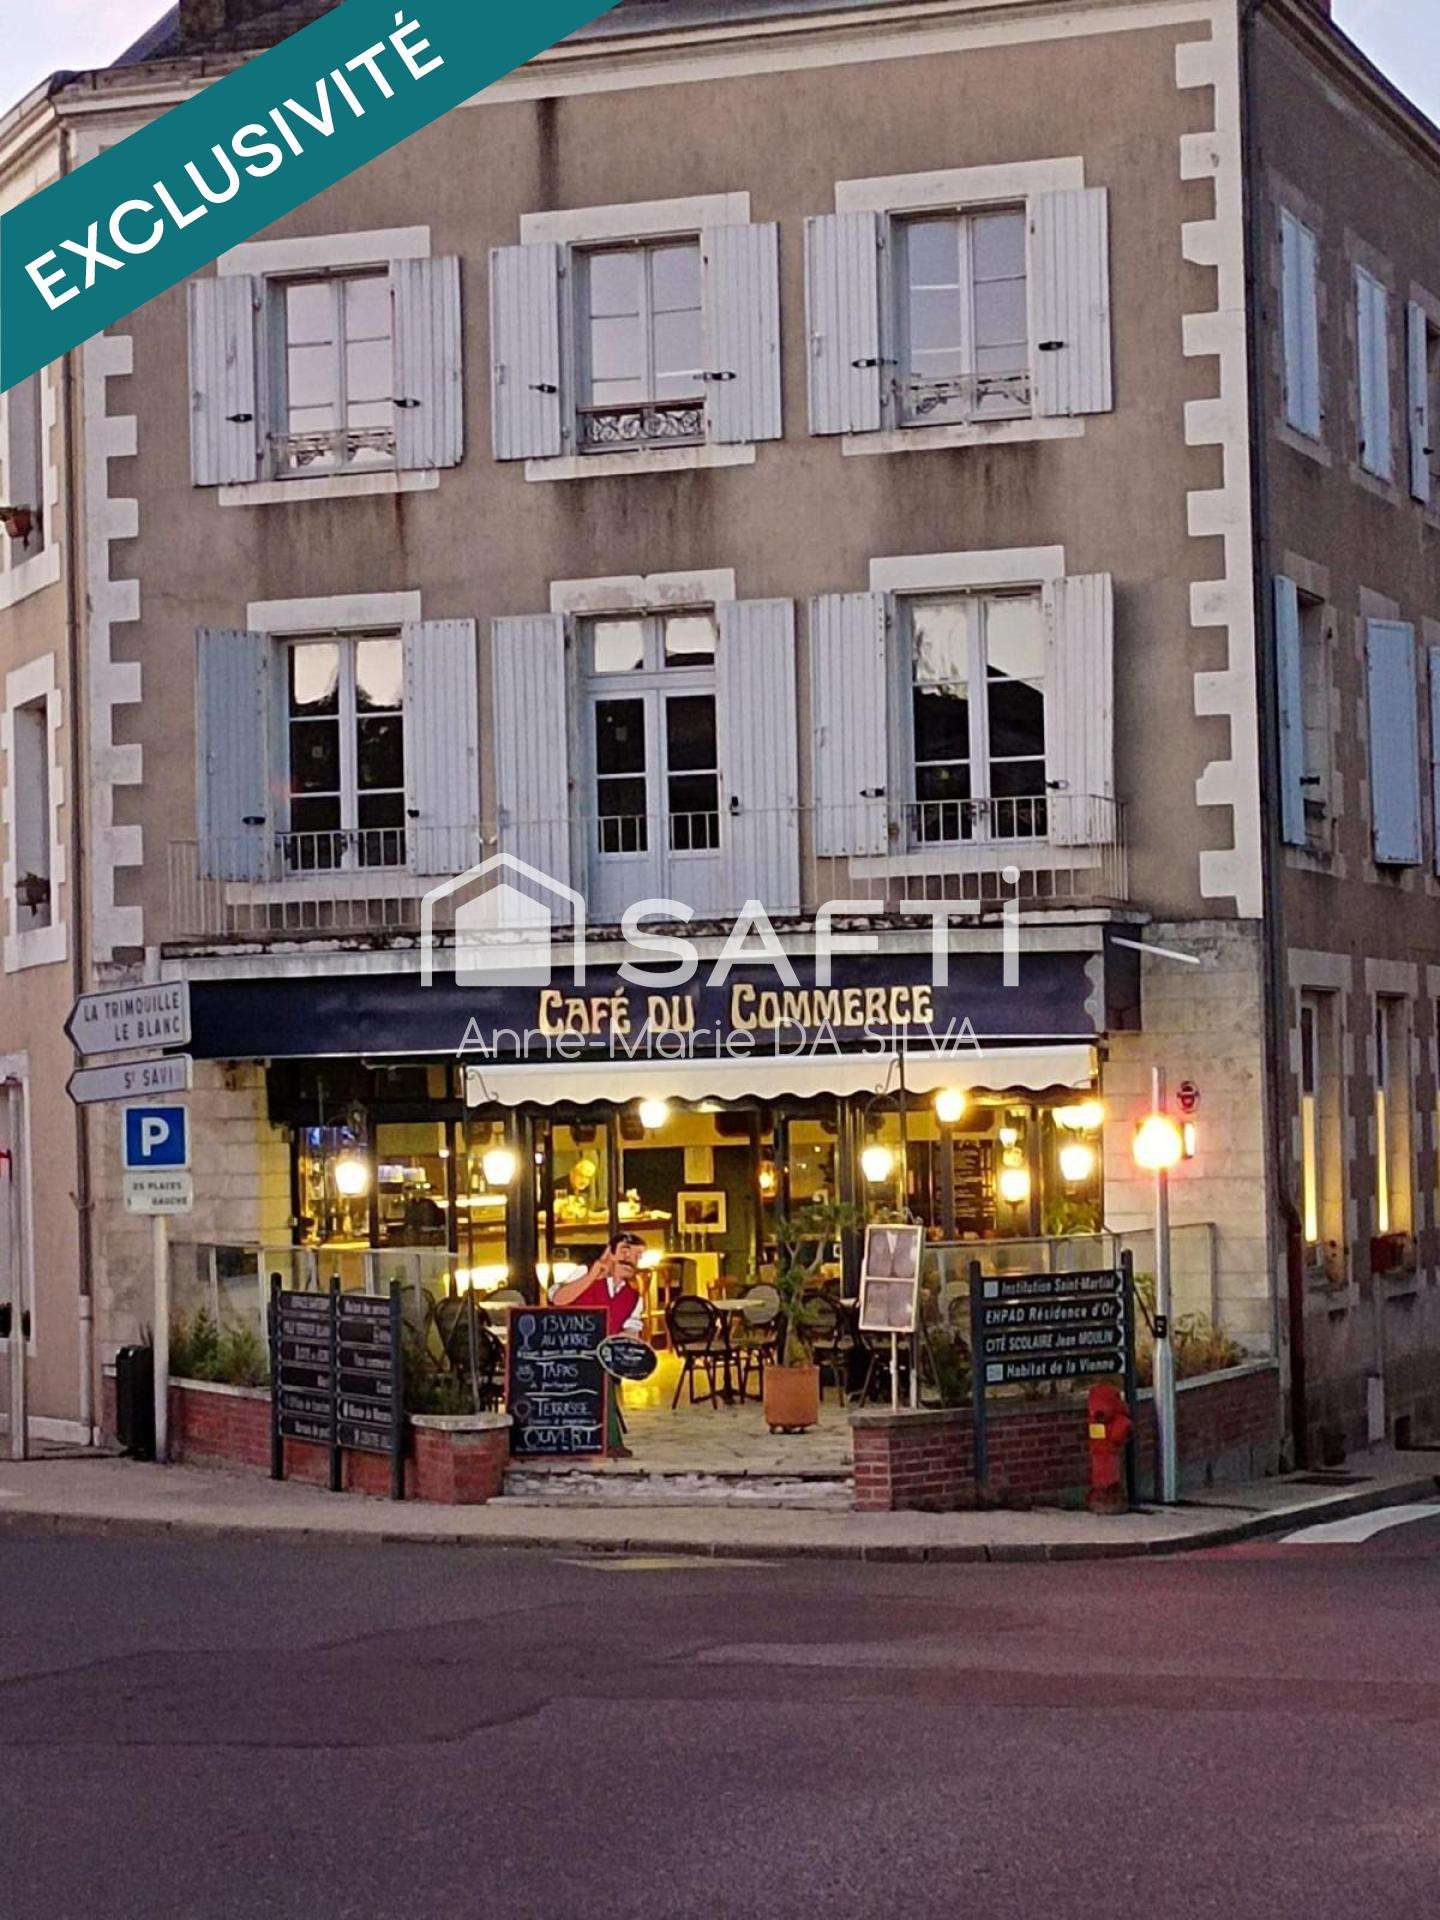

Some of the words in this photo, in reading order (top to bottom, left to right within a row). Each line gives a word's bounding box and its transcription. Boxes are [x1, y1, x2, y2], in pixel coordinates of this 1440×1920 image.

[84, 1005, 98, 1022] LA
[105, 992, 180, 1018] TRIMOUILLE
[115, 1023, 129, 1041] LE
[138, 1016, 180, 1038] BLANC
[141, 1118, 170, 1157] P
[1002, 1281, 1051, 1297] Institution
[1054, 1276, 1114, 1292] Saint-Martial
[986, 1308, 1025, 1324] EHPAD
[1029, 1305, 1087, 1321] Résidence
[541, 1334, 556, 1346] AU
[1009, 1334, 1053, 1350] SCOLAIRE
[1055, 1333, 1076, 1347] Jean
[1078, 1330, 1113, 1345] MOULIN
[1006, 1363, 1046, 1378] Habitat
[1050, 1361, 1063, 1375] de
[1066, 1360, 1076, 1374] la
[1080, 1358, 1114, 1372] Vienne
